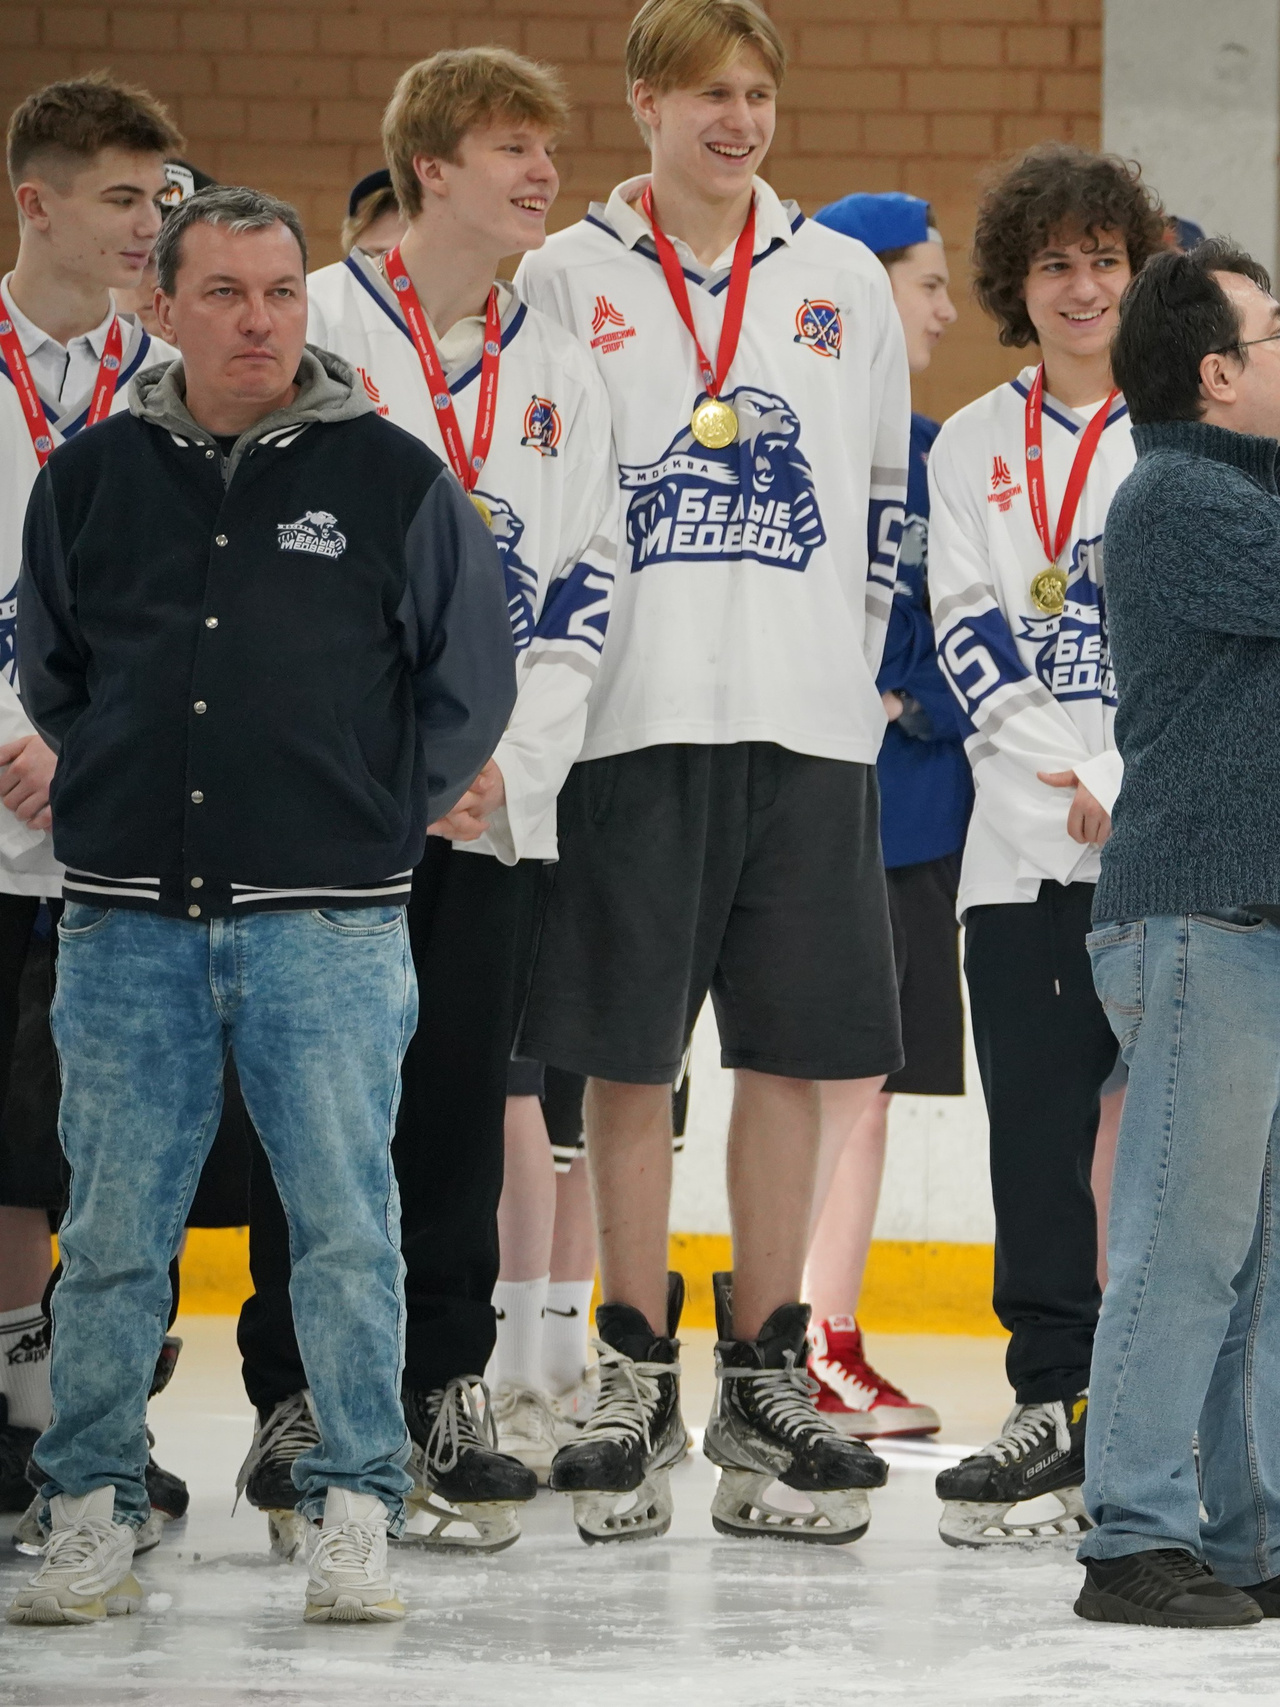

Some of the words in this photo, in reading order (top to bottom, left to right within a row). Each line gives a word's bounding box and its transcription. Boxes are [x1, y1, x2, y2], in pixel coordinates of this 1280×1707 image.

[803, 322, 840, 348] ФХМ
[601, 340, 624, 354] СПОРТ
[637, 459, 709, 482] МОСКВА
[676, 488, 792, 530] БЕЛЫЕ
[280, 539, 339, 558] МЕДВЕДИ
[295, 532, 336, 549] БЕЛЫЕ
[8, 1349, 49, 1366] Kapp
